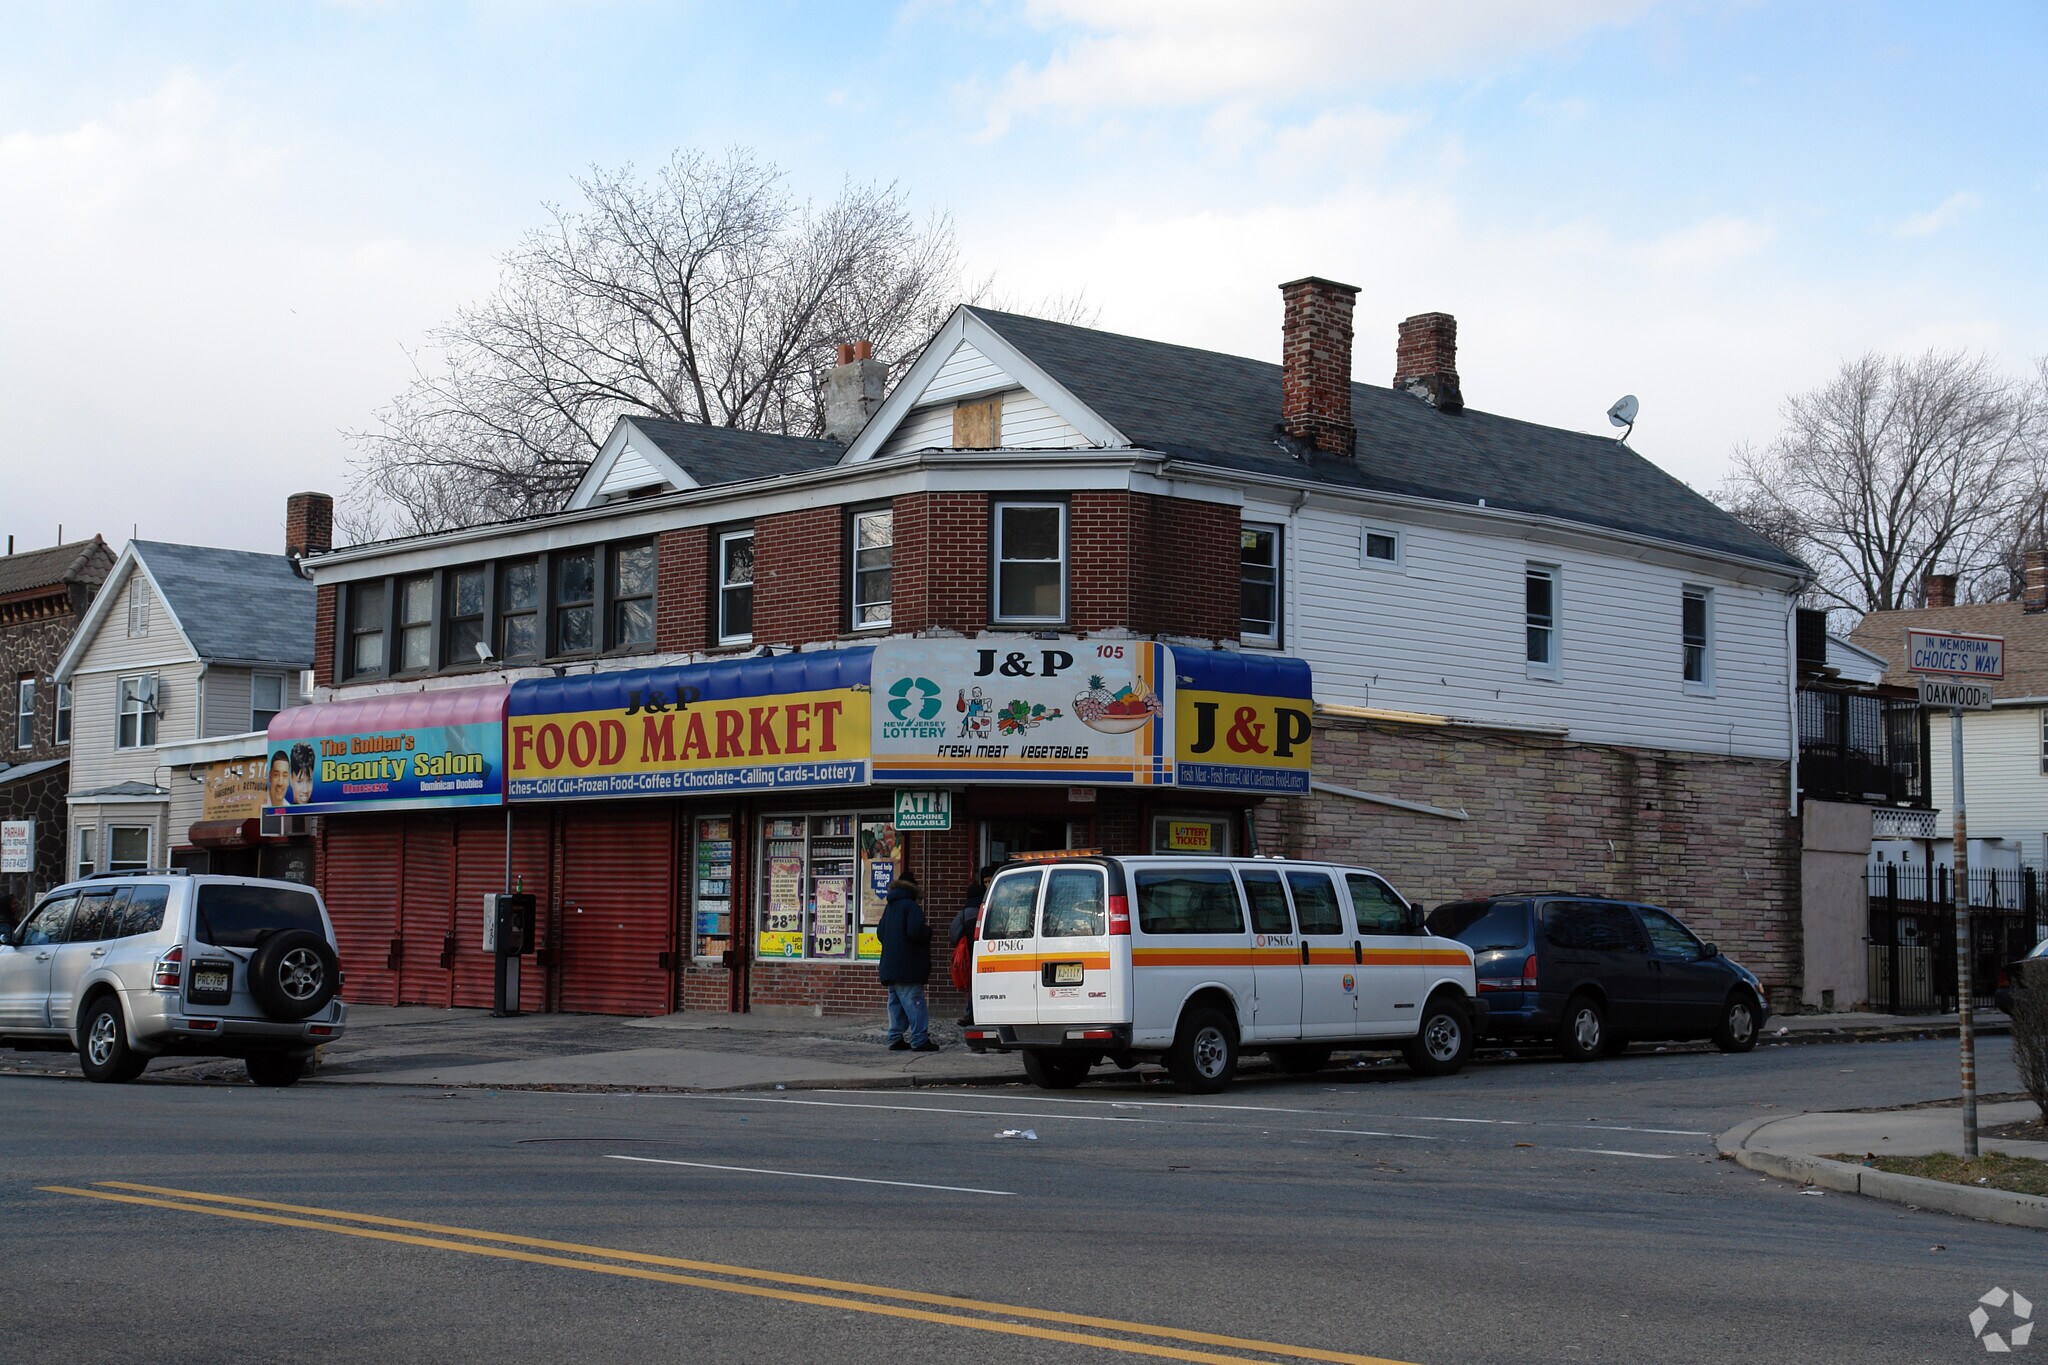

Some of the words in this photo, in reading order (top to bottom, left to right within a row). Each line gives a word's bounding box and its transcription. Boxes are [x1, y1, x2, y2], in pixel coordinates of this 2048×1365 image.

[1925, 636, 1934, 648] IN
[1940, 639, 1989, 653] MEMORIAM
[1096, 645, 1124, 659] 105
[1915, 650, 1968, 671] CHOICE'S
[1975, 655, 1999, 673] WAY
[1926, 684, 1980, 706] OAKWOOD
[1982, 692, 1990, 703] PL
[914, 720, 946, 728] JERSEY
[512, 719, 627, 770] FOOD
[640, 700, 843, 763] MARKET
[883, 728, 946, 739] LOTTERY
[320, 739, 347, 757] The
[350, 733, 415, 754] Golden's
[321, 756, 407, 782] Beauty
[413, 751, 483, 777] Salon
[1181, 765, 1193, 782] Fresh
[420, 780, 455, 792] Dominican
[673, 773, 683, 788] &
[898, 791, 948, 813] ATM
[900, 819, 947, 828] AVAILABLE
[902, 813, 944, 821] MACHINE
[1175, 826, 1209, 837] LOTTERY
[1175, 835, 1207, 846] TICKETS
[872, 863, 883, 871] Need
[883, 863, 893, 872] help
[997, 940, 1024, 951] PSEG
[1267, 935, 1293, 947] PSEG
